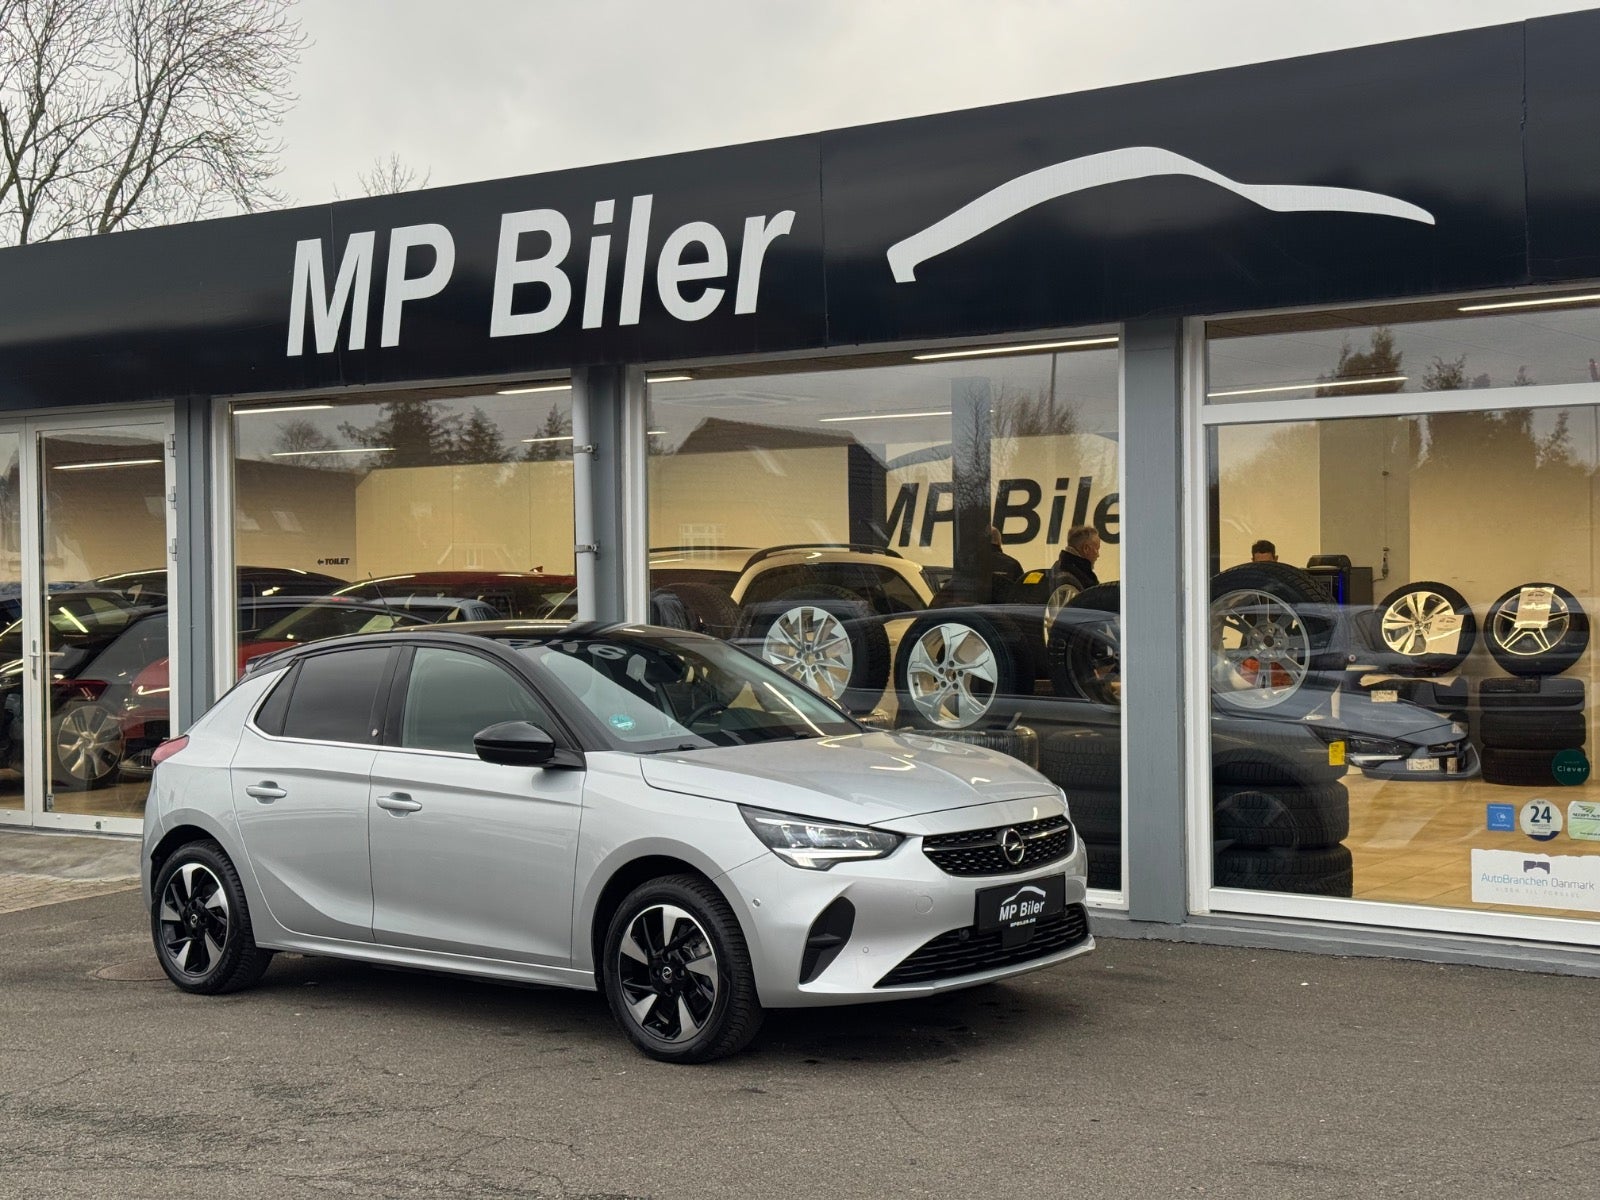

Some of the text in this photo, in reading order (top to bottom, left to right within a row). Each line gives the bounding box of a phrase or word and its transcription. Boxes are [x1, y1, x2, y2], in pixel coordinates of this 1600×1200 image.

[287, 194, 797, 357] MP Biler
[993, 475, 1121, 545] Bile
[1530, 805, 1552, 823] 24
[1481, 872, 1595, 890] AutoBranchen Danmark
[999, 901, 1045, 921] MP Biler
